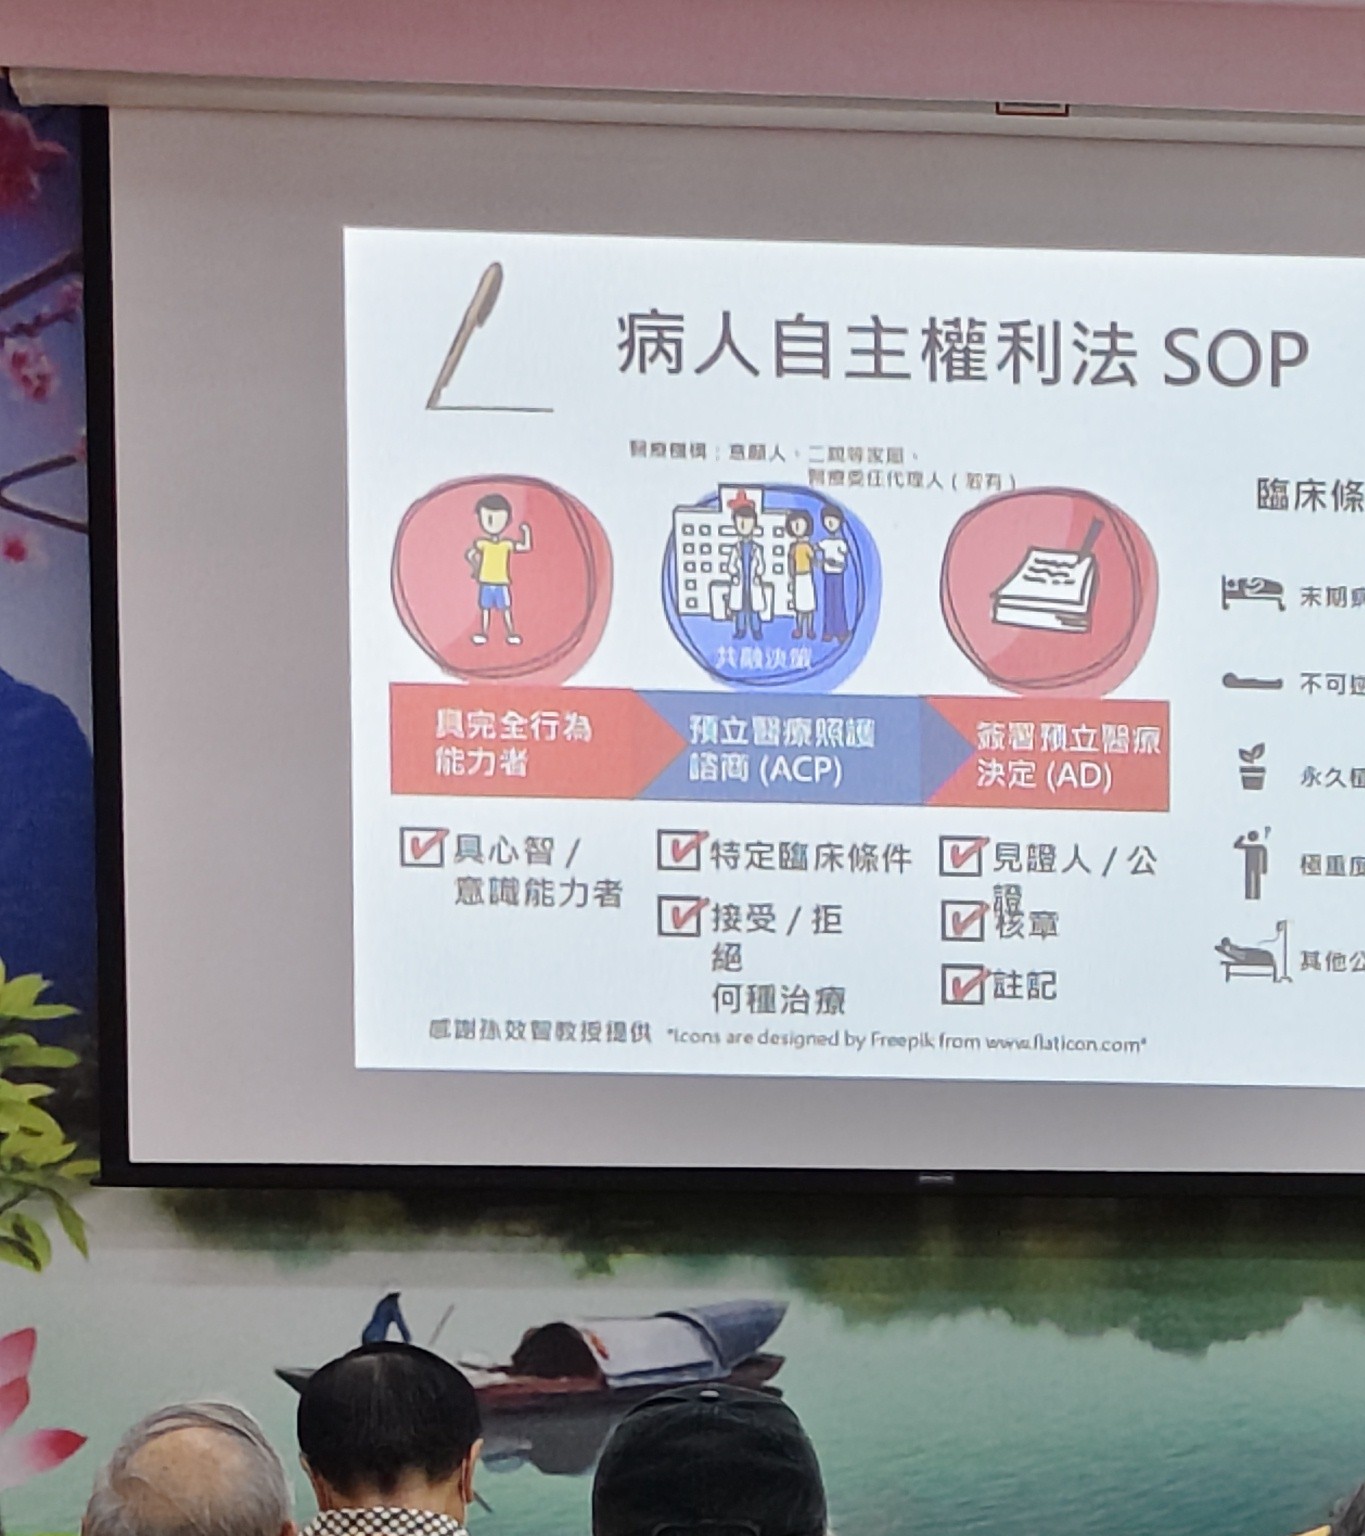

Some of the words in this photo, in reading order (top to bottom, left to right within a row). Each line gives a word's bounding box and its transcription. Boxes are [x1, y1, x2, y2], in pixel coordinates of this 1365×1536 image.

[617, 308, 1138, 388] 病人自主權利法
[1163, 327, 1309, 388] SOP
[435, 709, 592, 743] 具完全行為
[689, 714, 876, 749] 預立醫療照護
[976, 720, 1161, 755] 簽署預立醫療
[435, 747, 529, 778] 能力者
[689, 754, 749, 784] 諮商
[760, 756, 844, 787] (ACP)
[976, 758, 1036, 788] 決定
[1047, 760, 1113, 793] (AD)
[454, 833, 555, 865] 具心智
[710, 841, 912, 874] 特定臨床條件
[993, 843, 1092, 875] 見證人
[454, 878, 624, 909] 意識能力者
[712, 903, 775, 935] 接受
[995, 909, 1059, 940] 核章
[712, 943, 743, 972] 絕
[713, 984, 846, 1016] 何種治療
[993, 970, 1057, 1001] 註記
[726, 1033, 753, 1046] are
[757, 1028, 838, 1049] designed
[844, 1031, 866, 1051] by
[870, 1031, 933, 1053] Freepik
[938, 1032, 981, 1050] from
